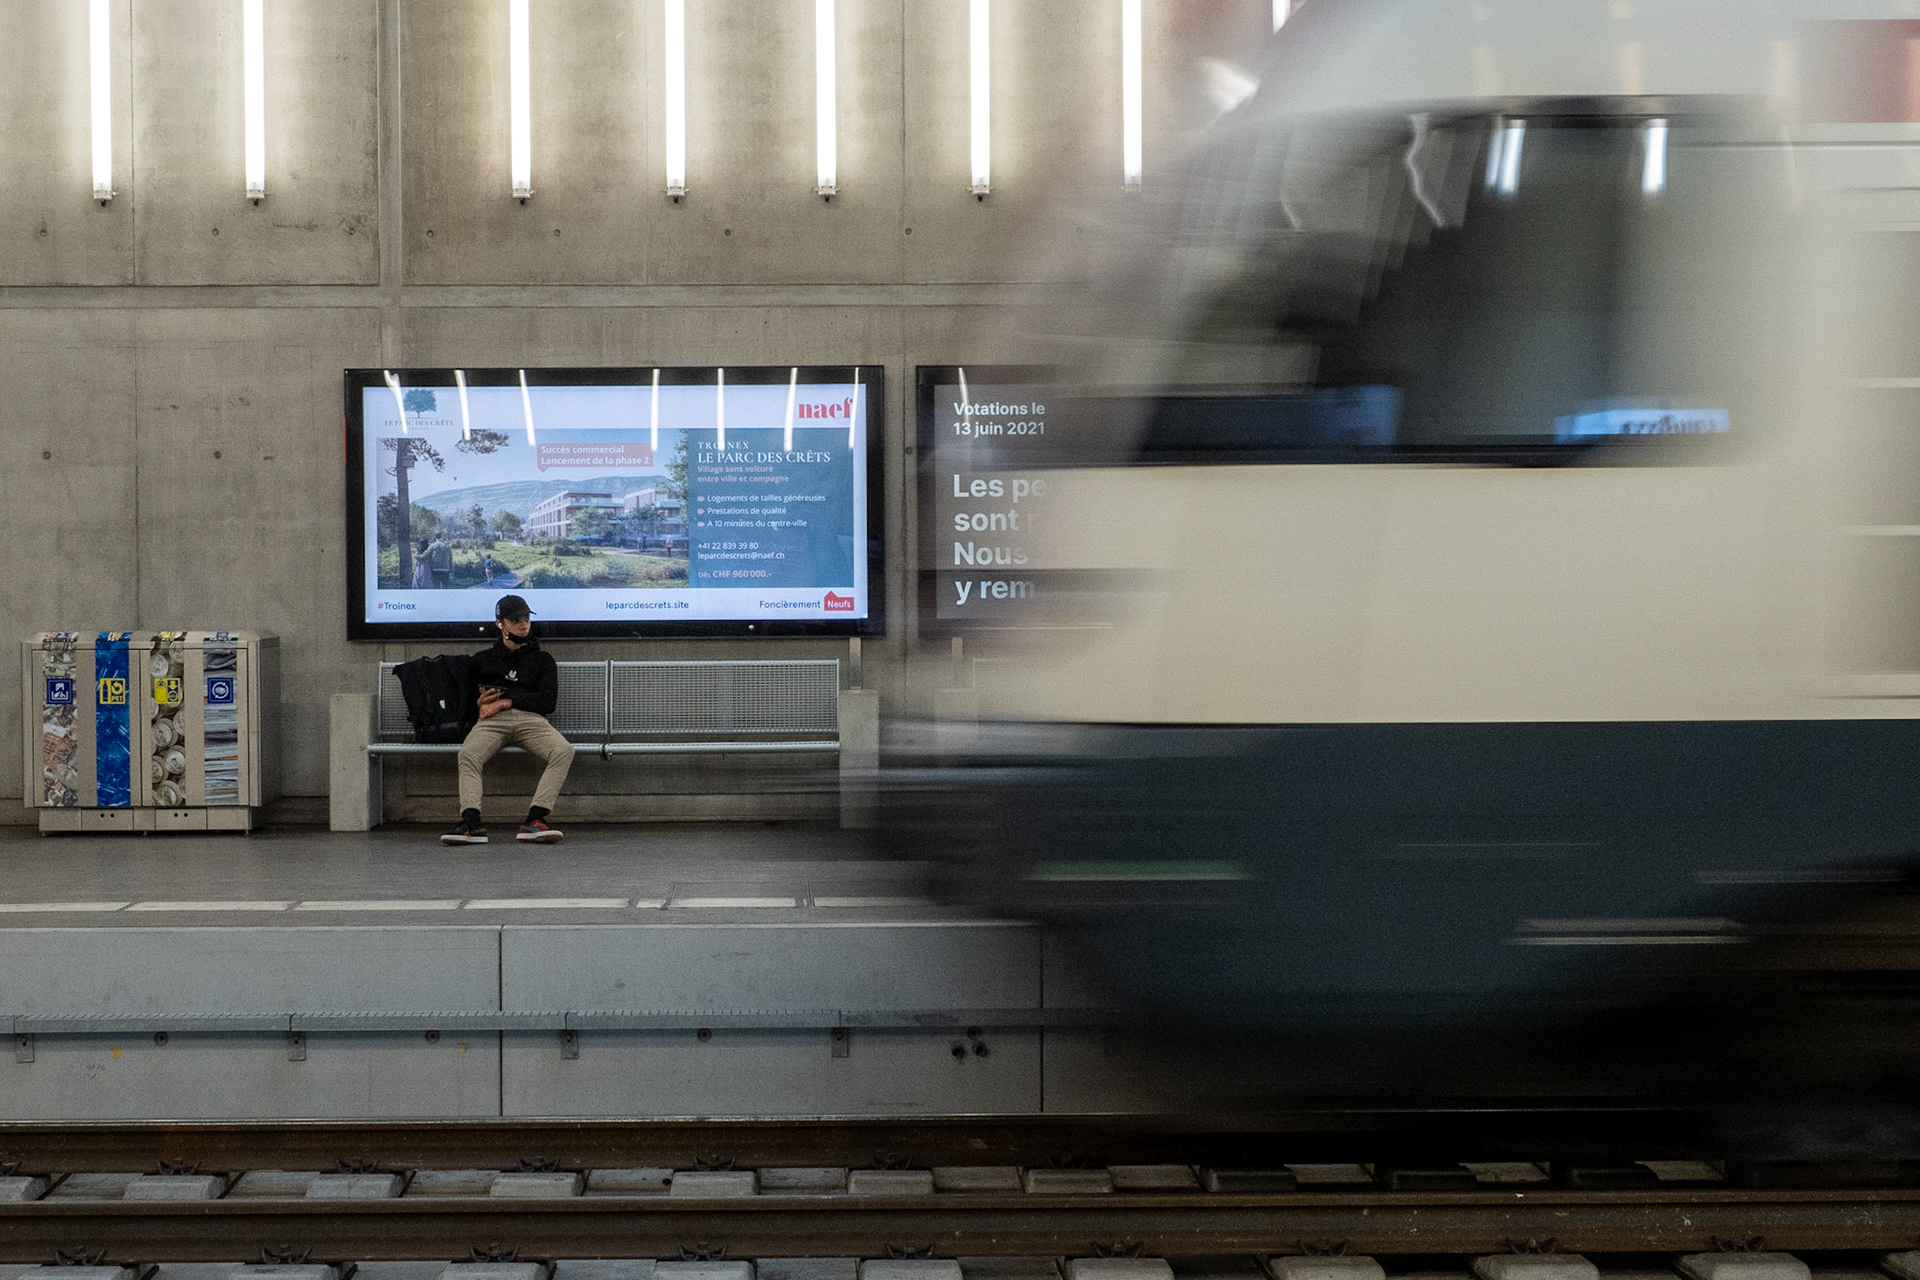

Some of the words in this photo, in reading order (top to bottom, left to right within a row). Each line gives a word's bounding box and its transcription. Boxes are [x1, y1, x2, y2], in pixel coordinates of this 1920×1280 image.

[798, 397, 853, 418] naef
[953, 402, 1028, 415] Votations
[1031, 402, 1046, 415] le
[953, 422, 971, 435] 13
[974, 421, 1003, 438] juin
[1007, 421, 1045, 435] 2021
[541, 445, 571, 454] Succès
[572, 445, 624, 454] commercial
[697, 441, 750, 450] TRONEX
[698, 452, 713, 463] LE
[717, 452, 754, 463] PARC
[757, 452, 783, 463] DES
[786, 449, 831, 463] CRÊTS
[541, 457, 590, 465] Lancement
[592, 457, 602, 465] de
[605, 457, 614, 465] la
[616, 457, 642, 467] phase
[697, 465, 722, 474] Village
[745, 465, 774, 473] voiture
[750, 476, 790, 484] campagne
[953, 474, 1005, 498] Les
[707, 495, 748, 503] Logements
[783, 495, 826, 503] généreuses
[761, 507, 787, 516] qualité
[767, 519, 808, 527] centre-ville
[954, 509, 1019, 531] sont
[697, 552, 785, 560] leparcdescrets@naef.ch
[954, 541, 1029, 566] Nous
[713, 570, 731, 578] CHF
[955, 581, 973, 606] y
[378, 601, 417, 610] #Troinex
[605, 600, 690, 610] leparcdescrets.site
[760, 601, 821, 609] Foncièrement
[827, 600, 851, 608] Neufs
